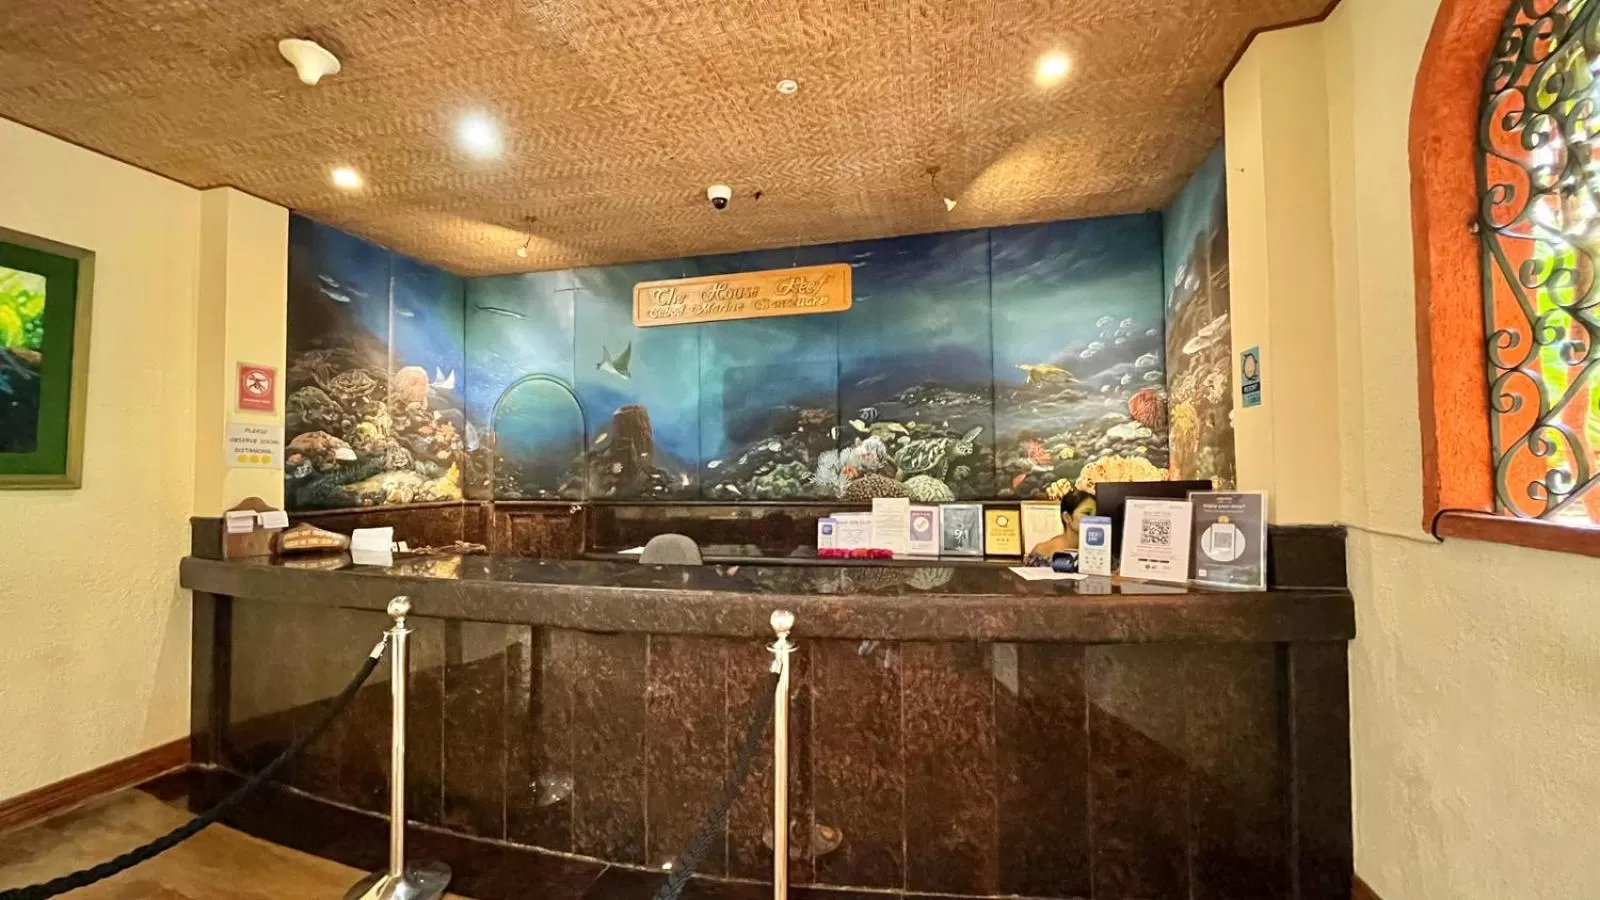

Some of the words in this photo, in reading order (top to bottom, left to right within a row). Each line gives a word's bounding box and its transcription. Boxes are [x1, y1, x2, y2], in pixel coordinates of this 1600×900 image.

[651, 286, 687, 306] The
[701, 281, 760, 302] House
[775, 270, 836, 297] Reef
